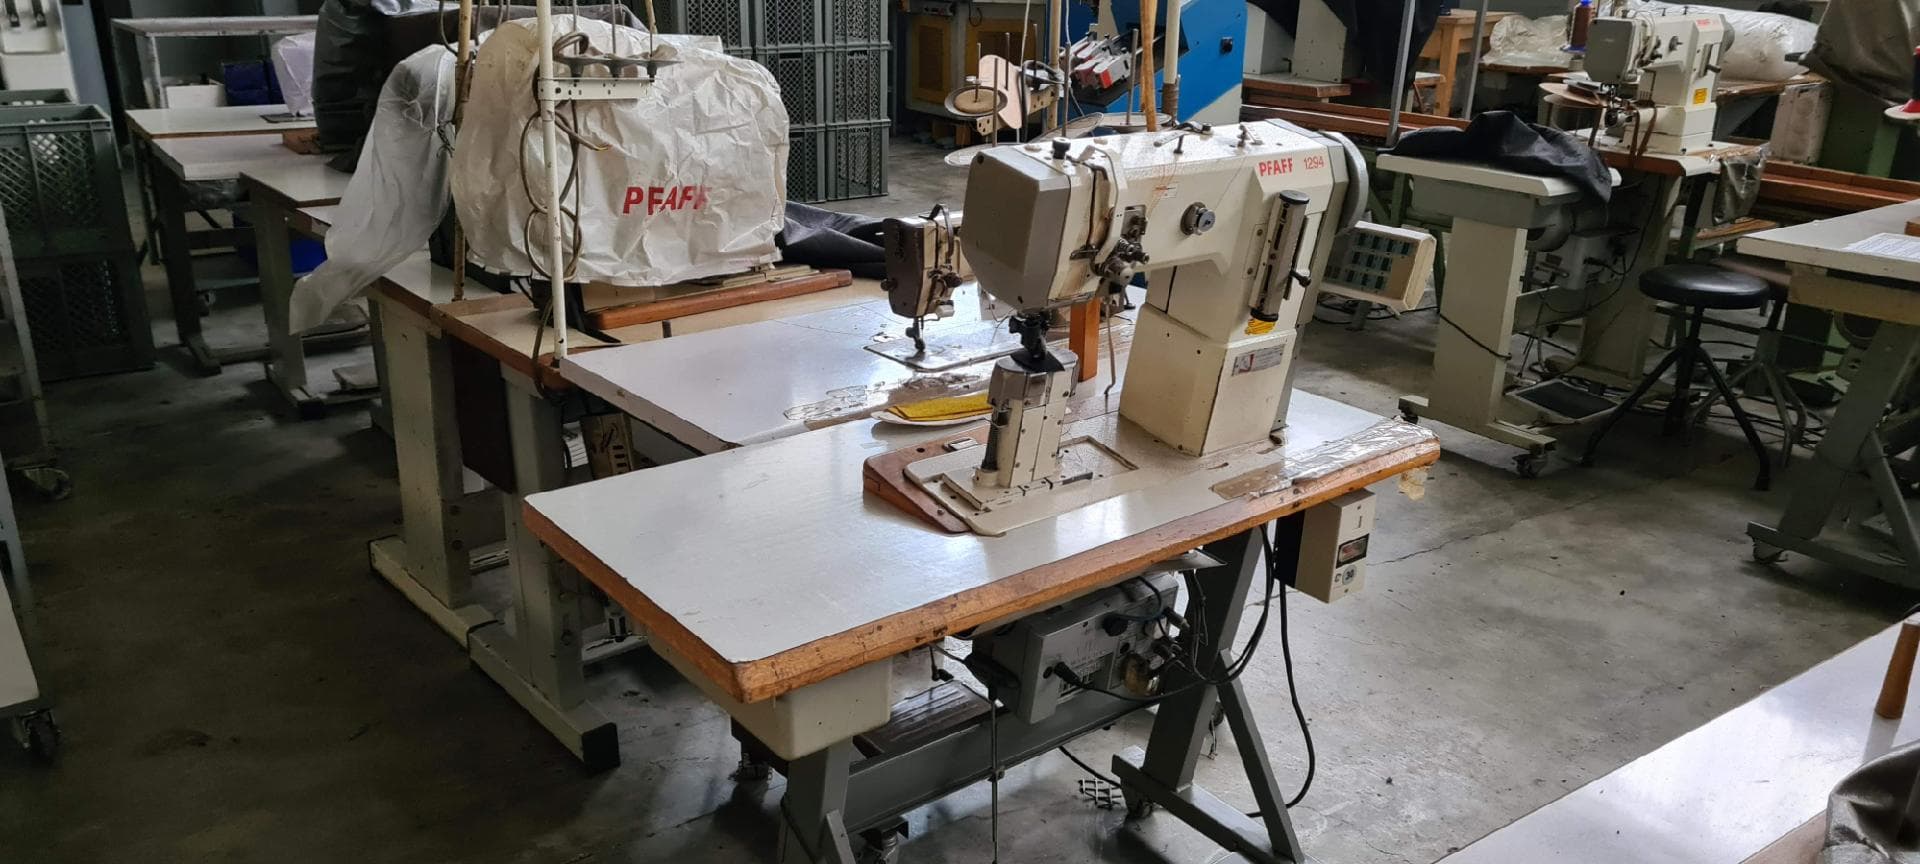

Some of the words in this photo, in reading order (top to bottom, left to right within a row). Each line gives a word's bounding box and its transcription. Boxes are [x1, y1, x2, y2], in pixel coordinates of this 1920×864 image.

[1259, 158, 1292, 176] PFAFF
[1304, 156, 1324, 169] 1294
[623, 186, 712, 215] PFAFF
